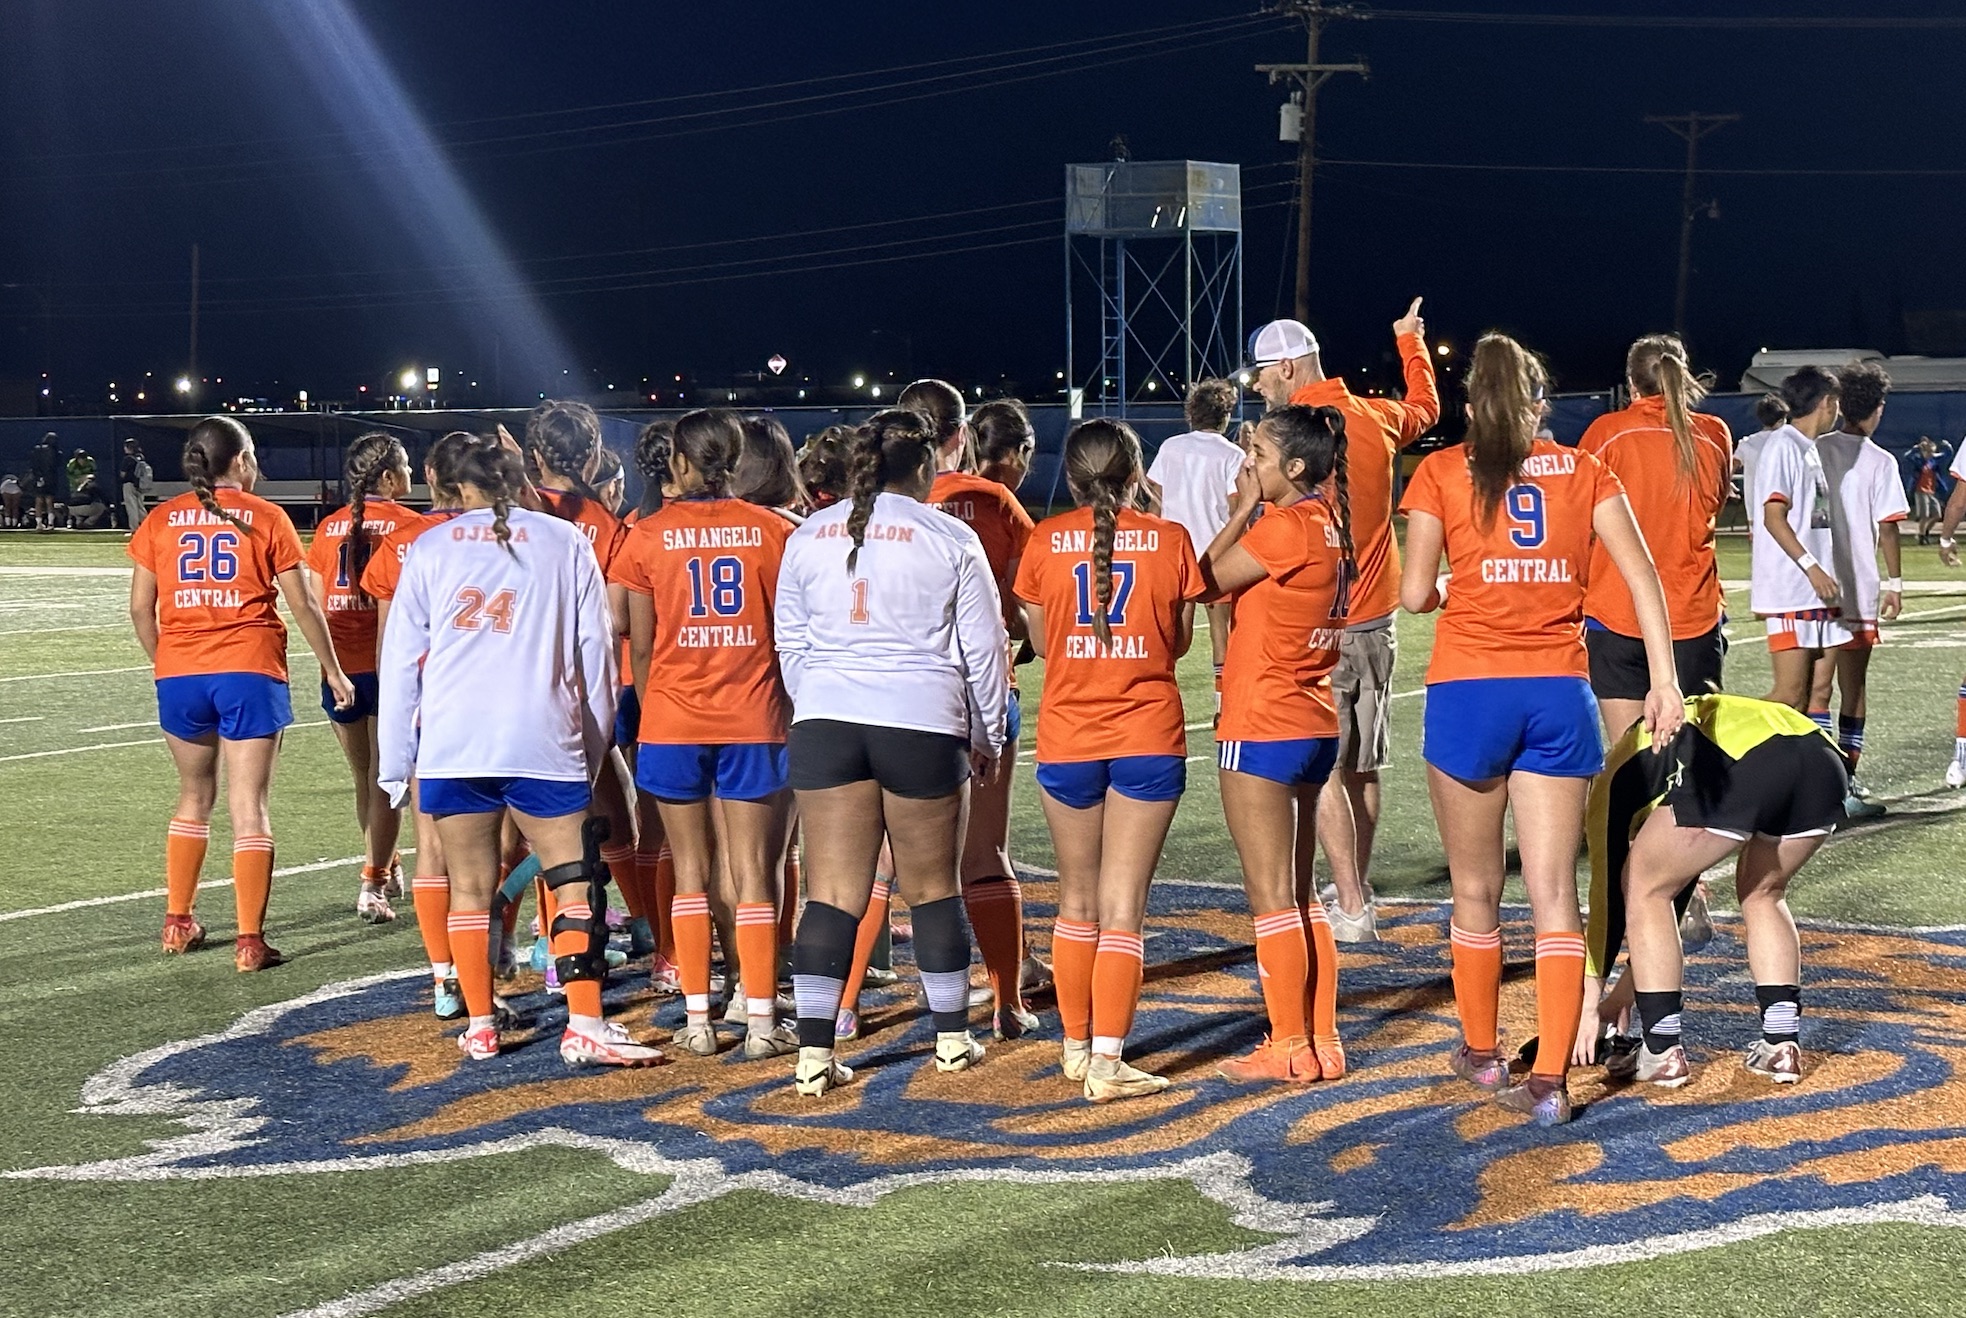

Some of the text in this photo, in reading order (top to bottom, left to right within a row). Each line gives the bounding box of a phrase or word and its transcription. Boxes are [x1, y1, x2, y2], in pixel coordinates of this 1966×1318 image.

[1519, 453, 1576, 477] NGELO
[168, 508, 196, 527] SAN
[1505, 483, 1547, 549] 9
[326, 520, 349, 537] SAN
[452, 525, 529, 542] OJEA
[663, 526, 762, 551] SAN ANGELO
[815, 523, 915, 542] AGULON
[1051, 530, 1158, 553] SAN GELO
[178, 531, 239, 583] 26
[1481, 558, 1571, 583] CENTRAL
[174, 588, 243, 609] CENTRAL
[686, 555, 745, 618] 18
[1072, 560, 1136, 627] 17
[453, 586, 517, 635] 24
[851, 578, 869, 625] 1
[677, 624, 757, 648] CENTRAL
